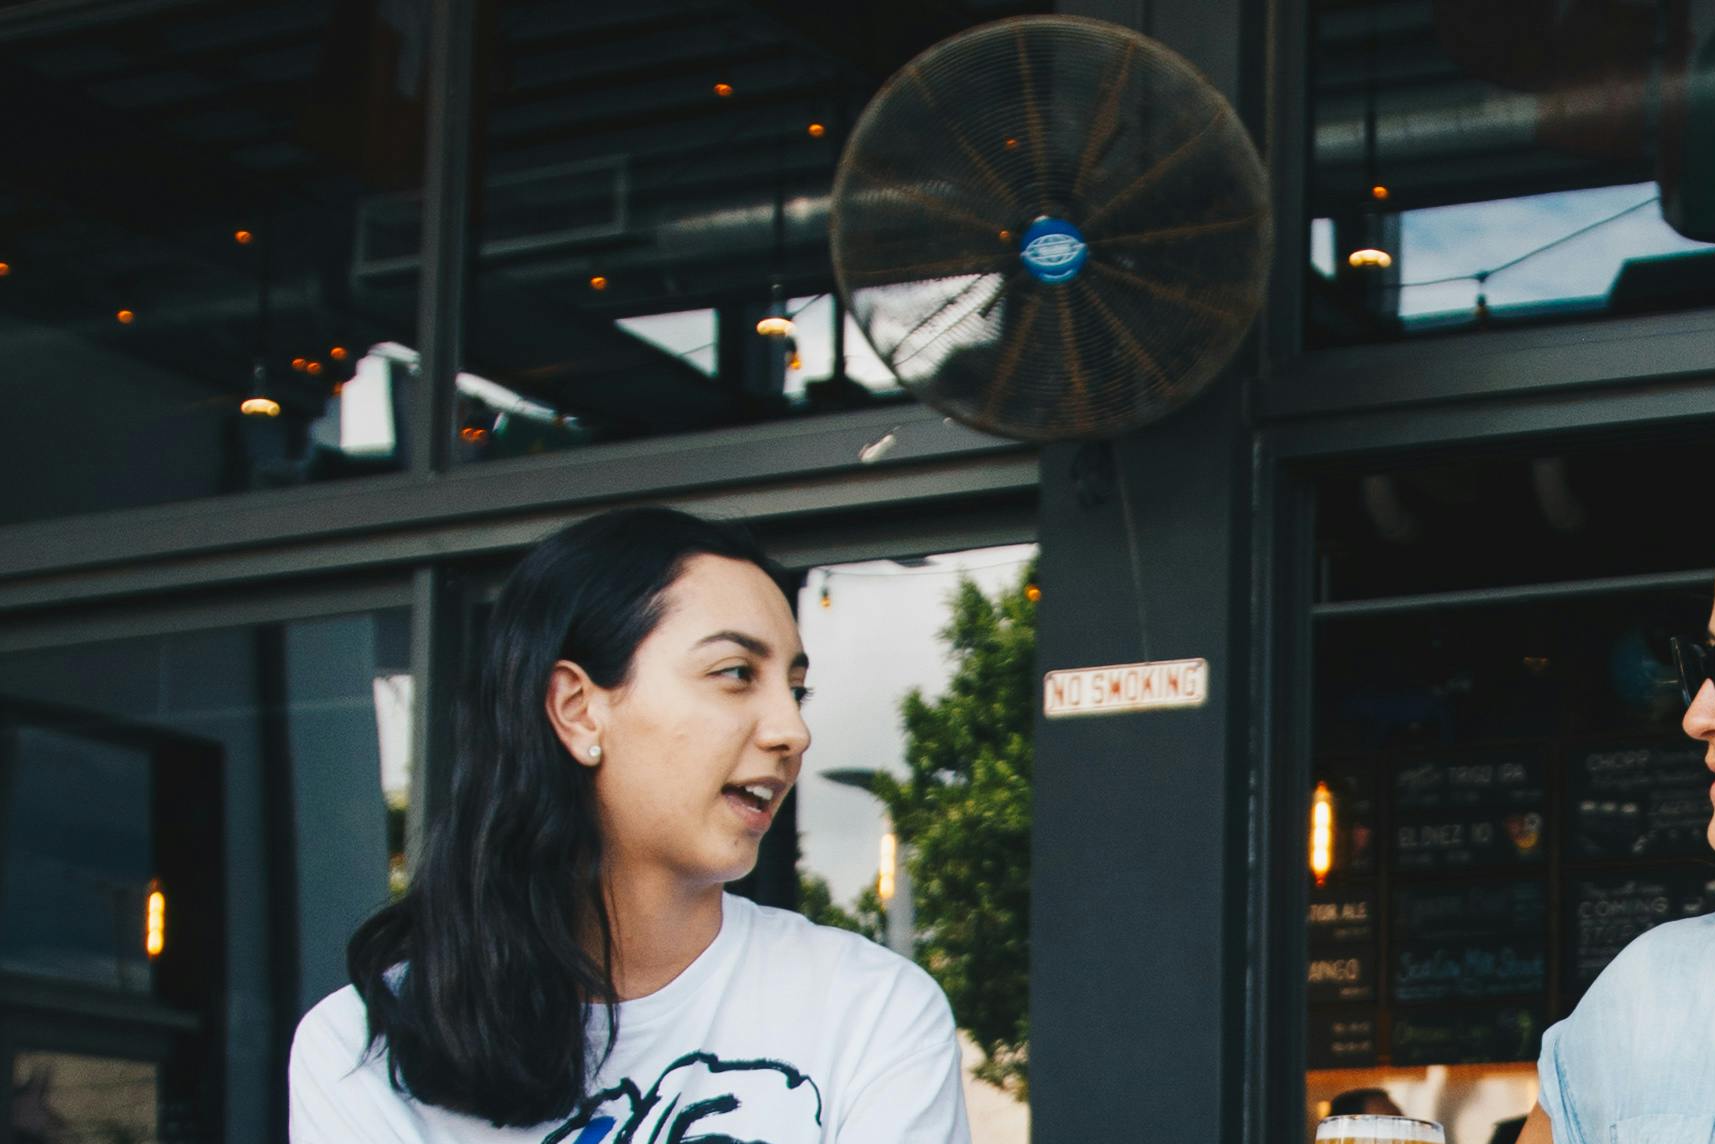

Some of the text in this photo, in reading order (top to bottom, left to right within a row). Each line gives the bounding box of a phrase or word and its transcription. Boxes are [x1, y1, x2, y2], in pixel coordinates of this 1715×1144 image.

[1051, 667, 1197, 707] NO SMOKING
[1308, 958, 1360, 982] ANGO
